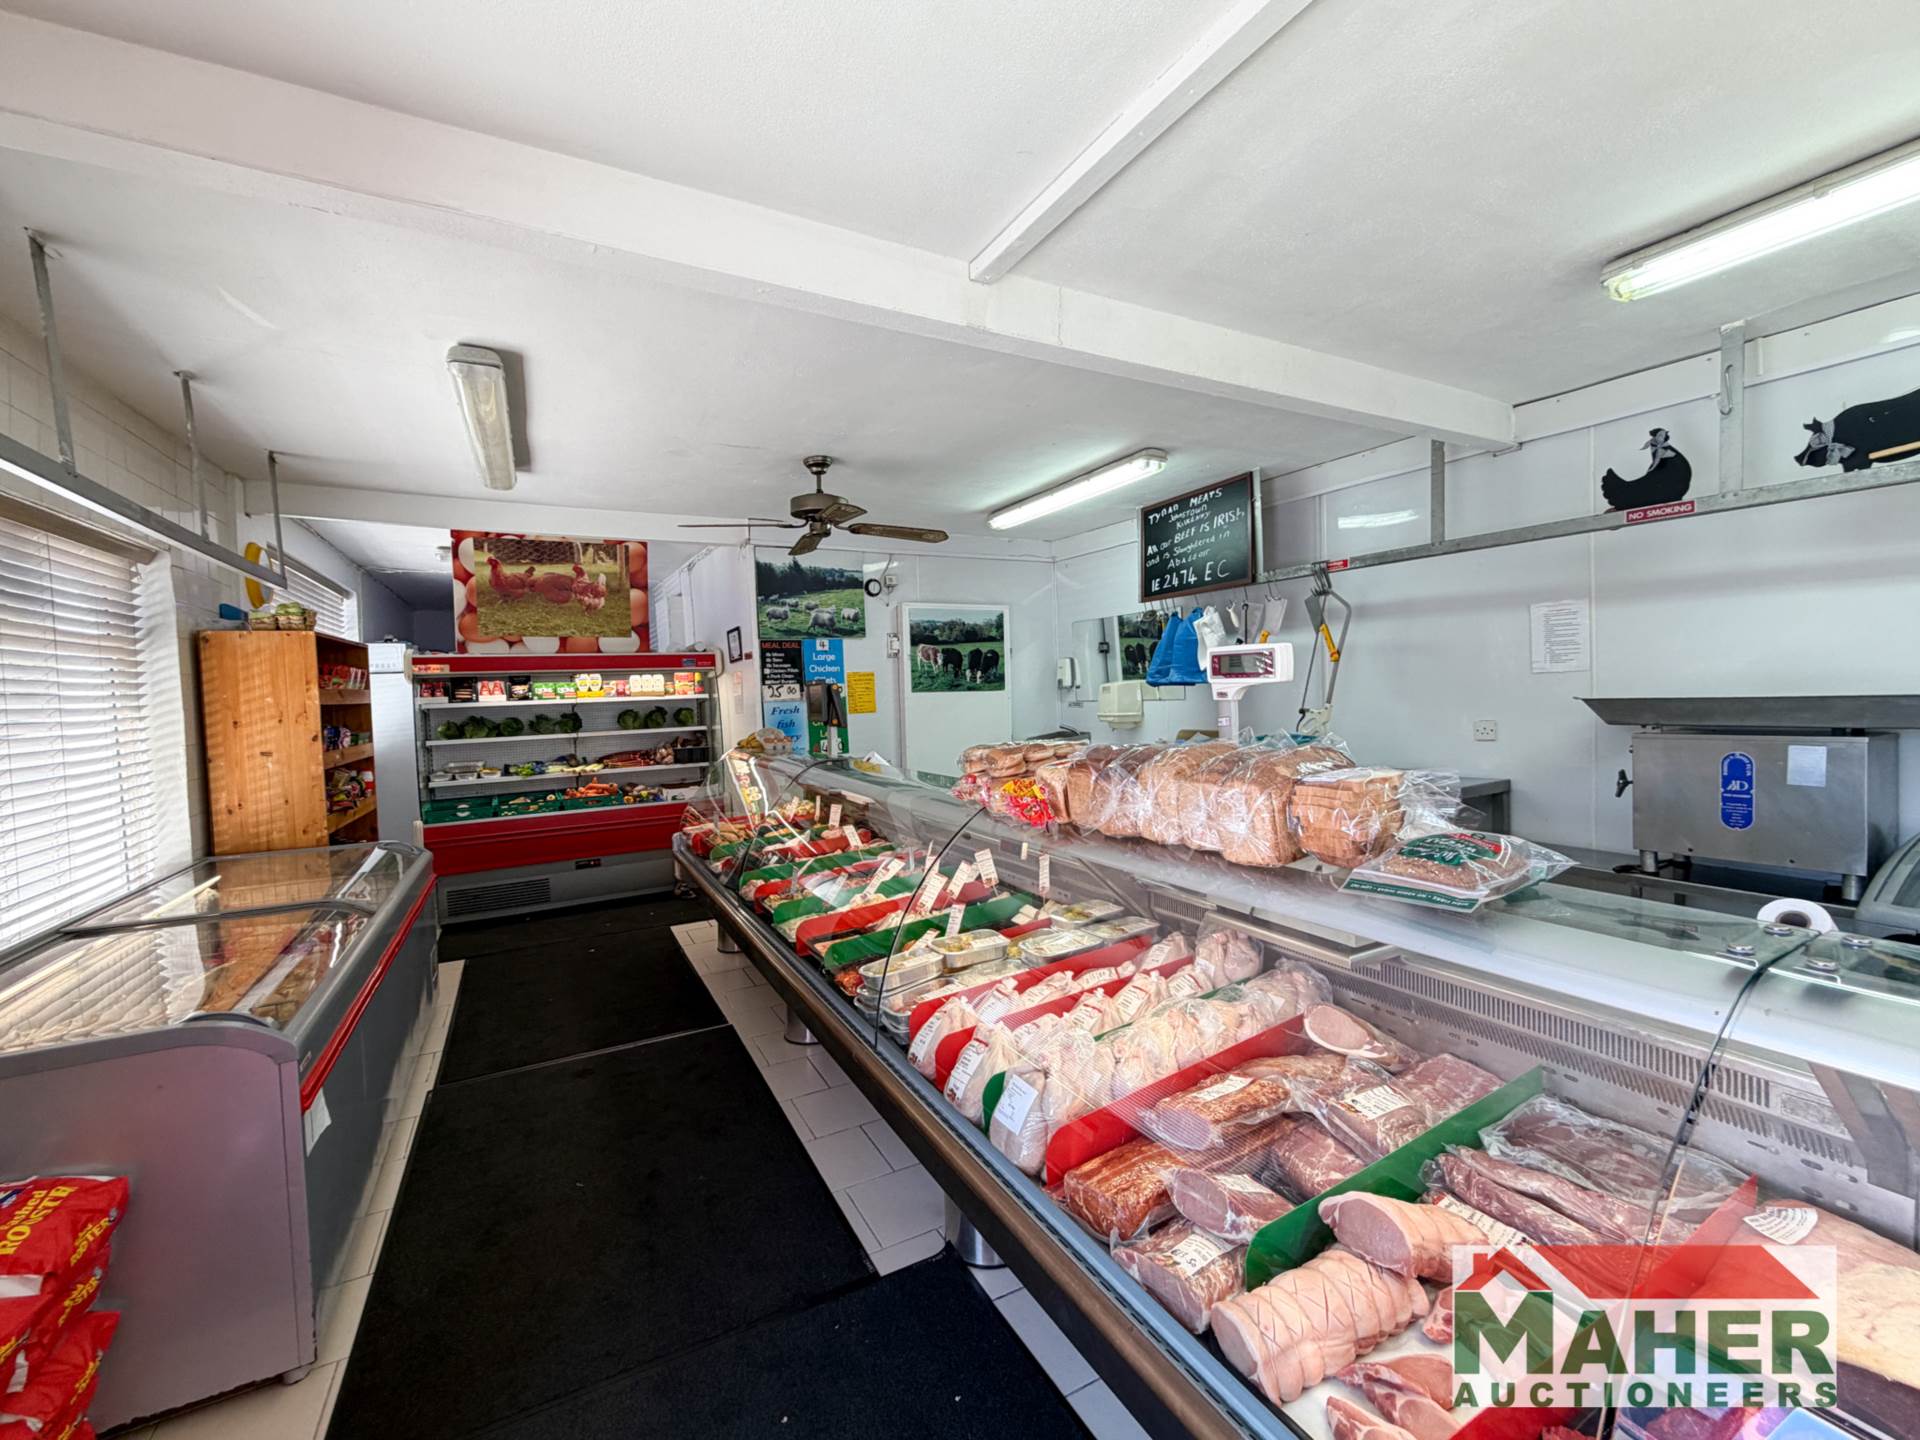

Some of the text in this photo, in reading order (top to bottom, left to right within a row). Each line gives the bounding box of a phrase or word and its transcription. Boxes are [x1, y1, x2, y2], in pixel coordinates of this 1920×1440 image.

[1189, 488, 1223, 507] MEATS
[1628, 503, 1693, 521] NO SMOKING
[1174, 527, 1196, 544] BEEF
[1199, 521, 1210, 533] IS
[762, 641, 801, 649] MEAL DEAL
[812, 653, 836, 662] Large
[809, 664, 841, 673] Chicken
[771, 706, 800, 715] Fresh
[777, 720, 796, 729] fish
[0, 1190, 48, 1230] ashed
